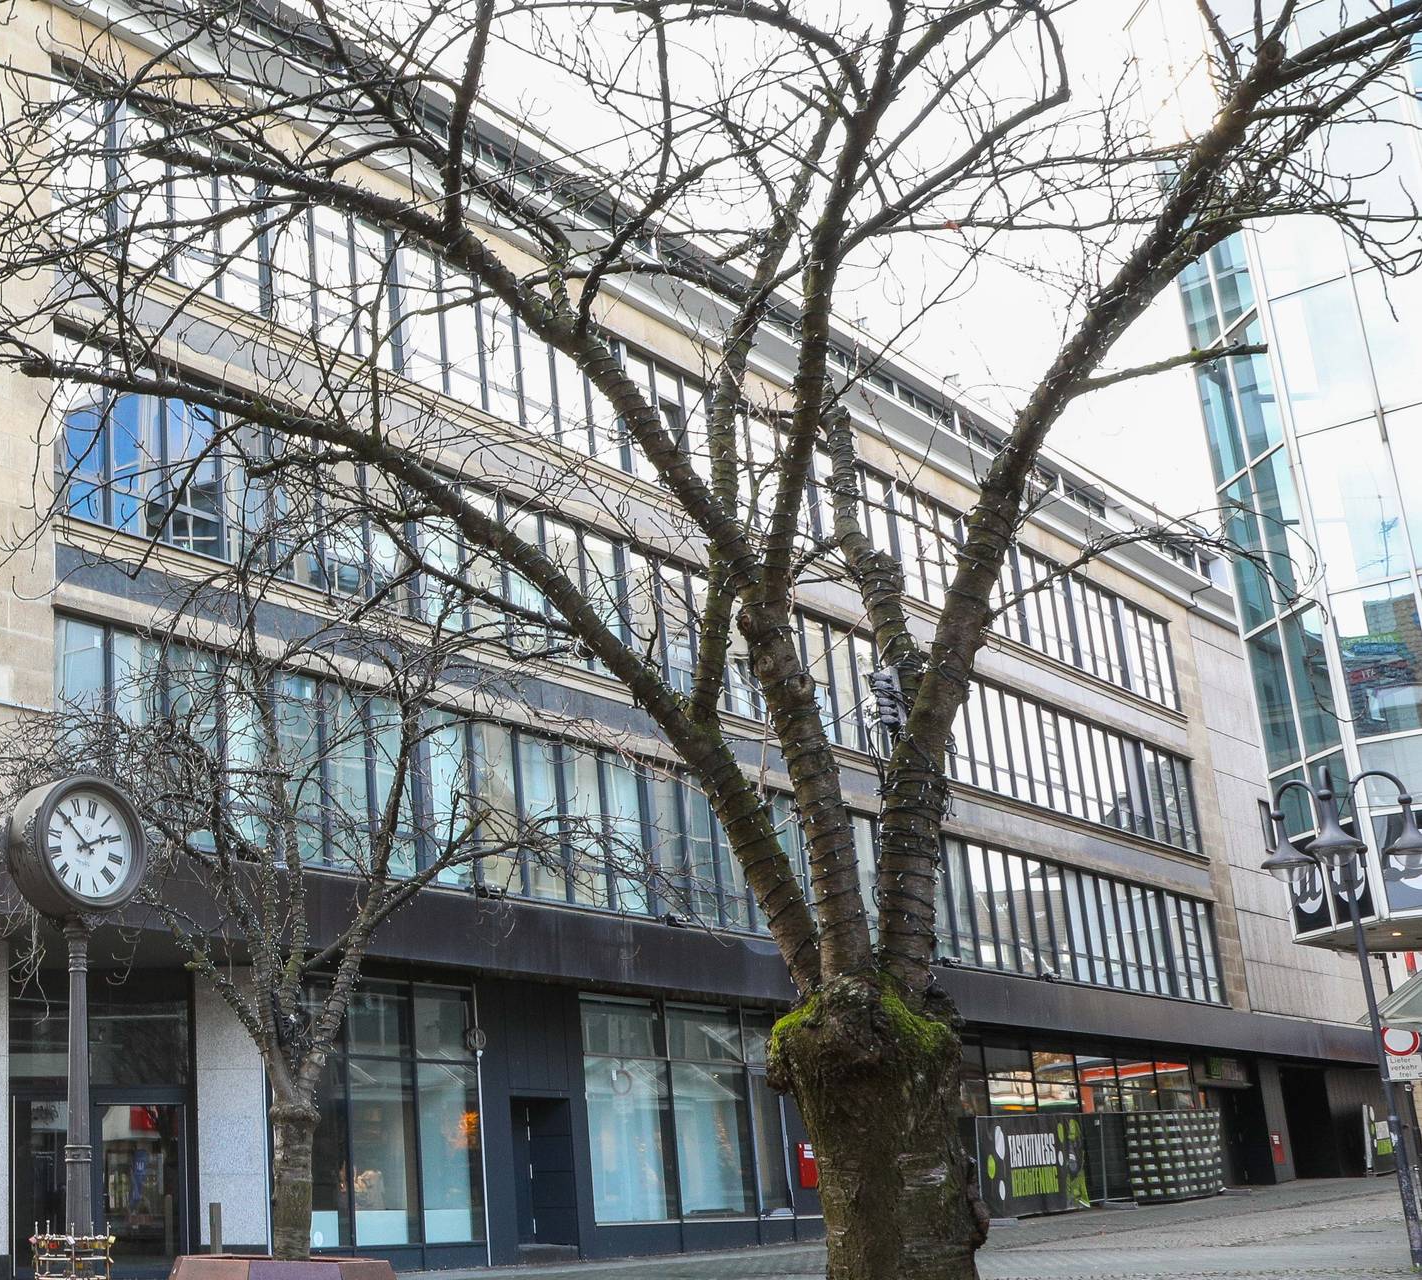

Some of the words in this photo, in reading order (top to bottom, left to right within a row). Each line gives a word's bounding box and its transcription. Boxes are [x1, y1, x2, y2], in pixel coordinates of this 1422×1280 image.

[69, 798, 81, 816] XI
[85, 799, 99, 820] XII
[48, 827, 63, 840] IX
[107, 852, 123, 867] III
[1007, 1132, 1056, 1168] EASYFITNESS
[1010, 1165, 1059, 1198] NEUERÖFFNUNG
